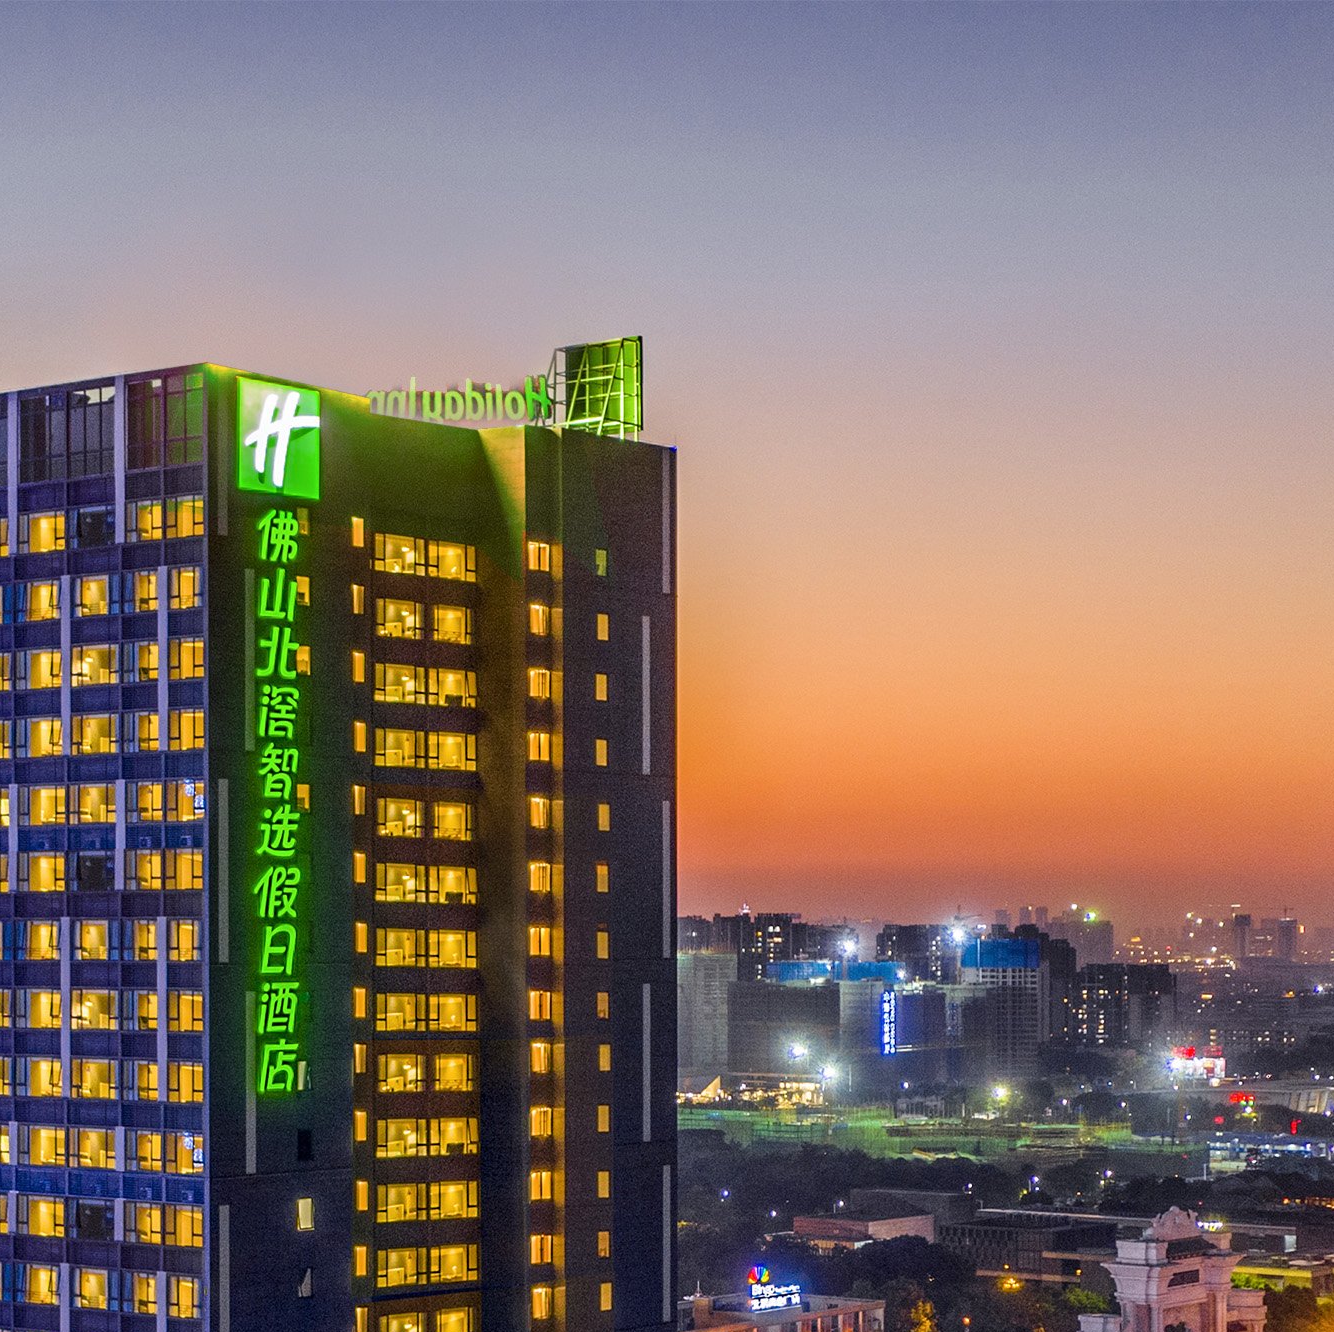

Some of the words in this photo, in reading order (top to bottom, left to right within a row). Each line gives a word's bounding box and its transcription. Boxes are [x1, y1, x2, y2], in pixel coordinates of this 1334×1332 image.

[254, 509, 301, 1095] 佛山北滘智选假日酒店
